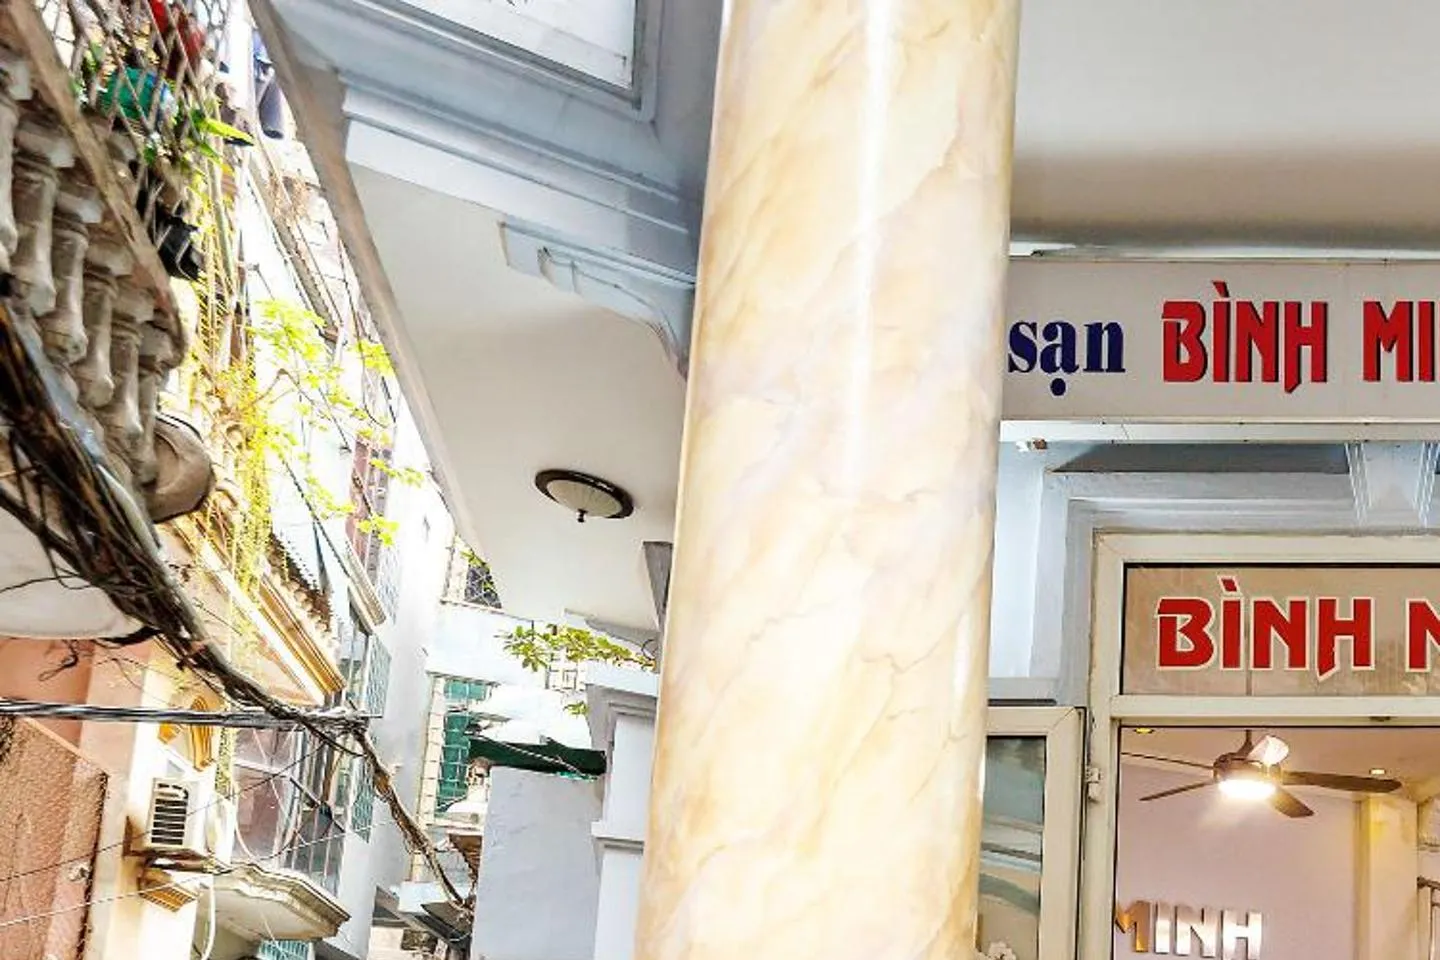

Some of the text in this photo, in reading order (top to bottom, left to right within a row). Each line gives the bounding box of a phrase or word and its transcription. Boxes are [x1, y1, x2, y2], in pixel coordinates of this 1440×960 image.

[1007, 320, 1126, 397] sạn
[1161, 280, 1330, 394] BÌNH
[1156, 575, 1376, 681] BÌNH
